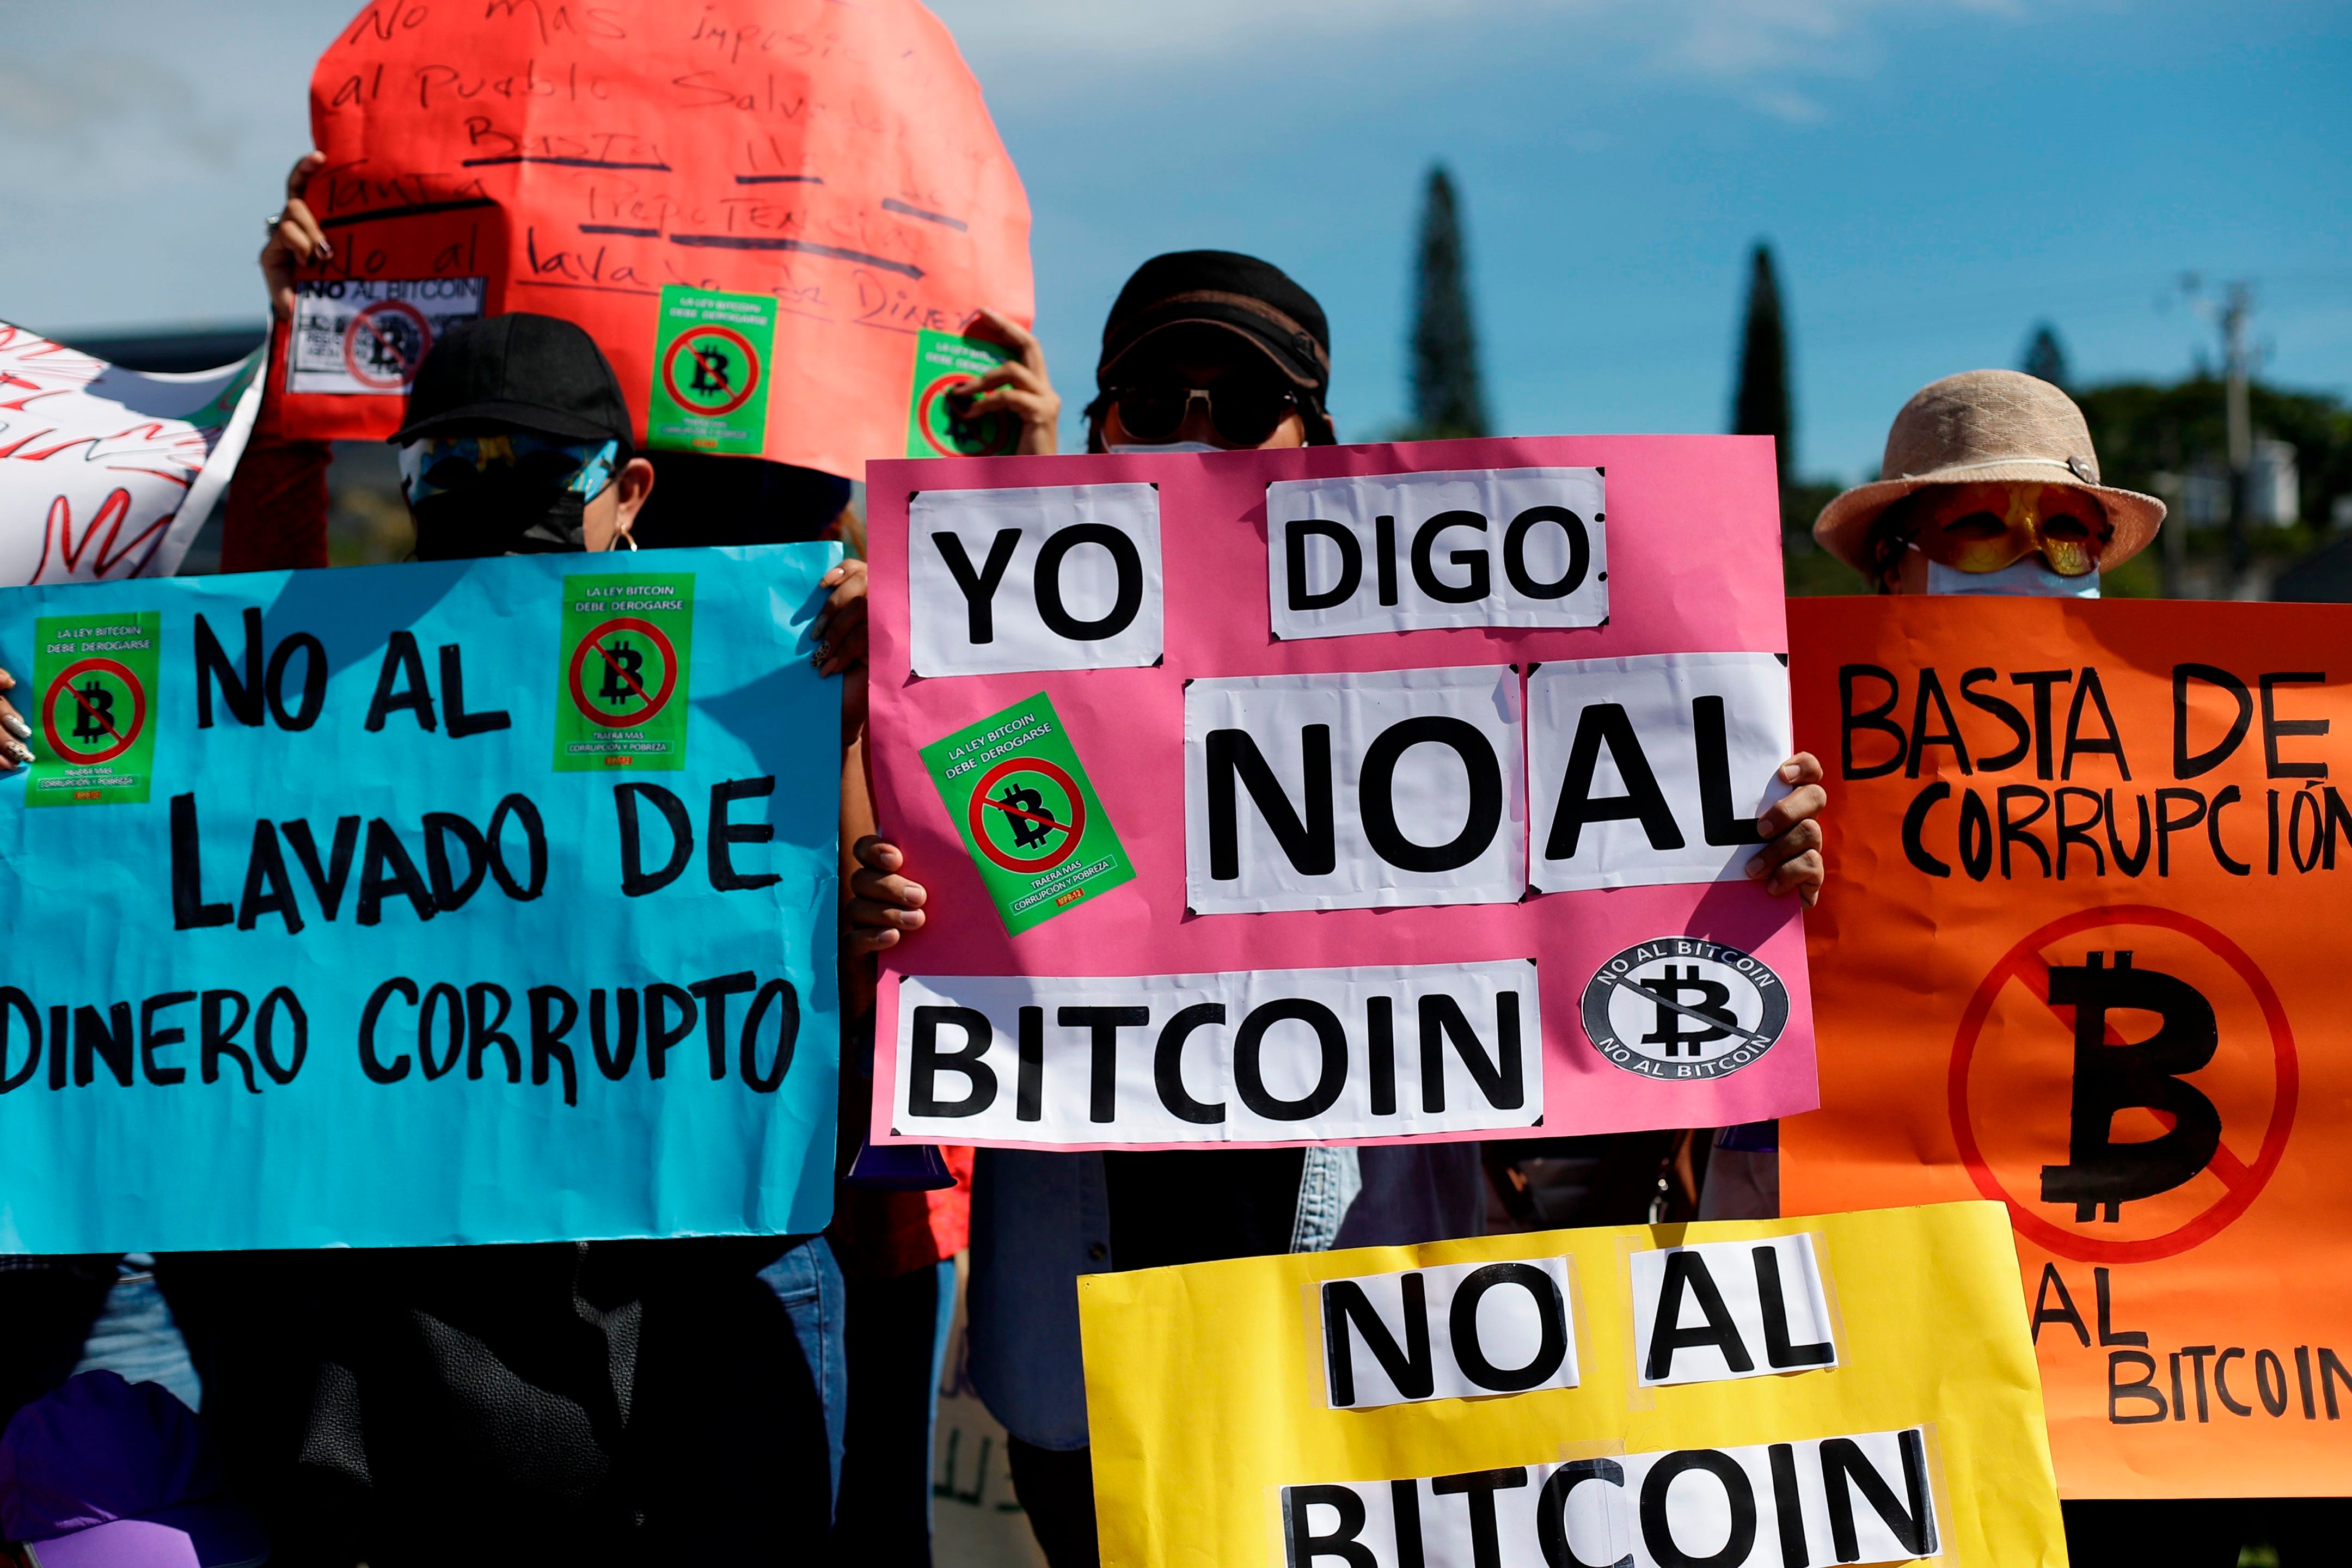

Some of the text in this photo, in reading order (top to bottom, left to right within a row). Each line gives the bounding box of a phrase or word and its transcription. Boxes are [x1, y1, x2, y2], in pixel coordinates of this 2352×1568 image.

[331, 63, 383, 107] al
[434, 222, 480, 273] al
[305, 278, 478, 299] NO AL BITCOIN
[586, 586, 675, 597] LA LEY BITCOIN
[931, 505, 1590, 645] YO DIGO
[57, 626, 142, 639] LA LEY BITCOIN
[575, 600, 683, 612] DEBE DEROGARSE
[46, 639, 151, 654] DEBE DEROGARSE
[194, 607, 511, 738] NO AL
[948, 713, 1036, 761] LA LEY BITCOIN
[1837, 663, 2330, 781] BASTA DE
[945, 721, 1052, 780] DEBE DEROGARSE
[1205, 695, 1763, 881] NO AL
[170, 775, 783, 935] LAVADO DE
[1901, 780, 2352, 882] CORRUPCIÓN
[1014, 880, 1067, 911] CORRUPCIÓN
[1073, 860, 1110, 883] POBREZA
[1062, 860, 1082, 874] MAS
[1596, 941, 1776, 988] NO AL BITCOIN
[0, 970, 800, 1107] DINERO CORRUPTO
[908, 990, 1527, 1124] BITCOIN
[1598, 1034, 1772, 1078] NO AL BITCOIN
[1322, 1246, 1834, 1407] NO AL
[2031, 1262, 2148, 1349] AL
[1281, 1429, 1937, 1568] BITCOIN
